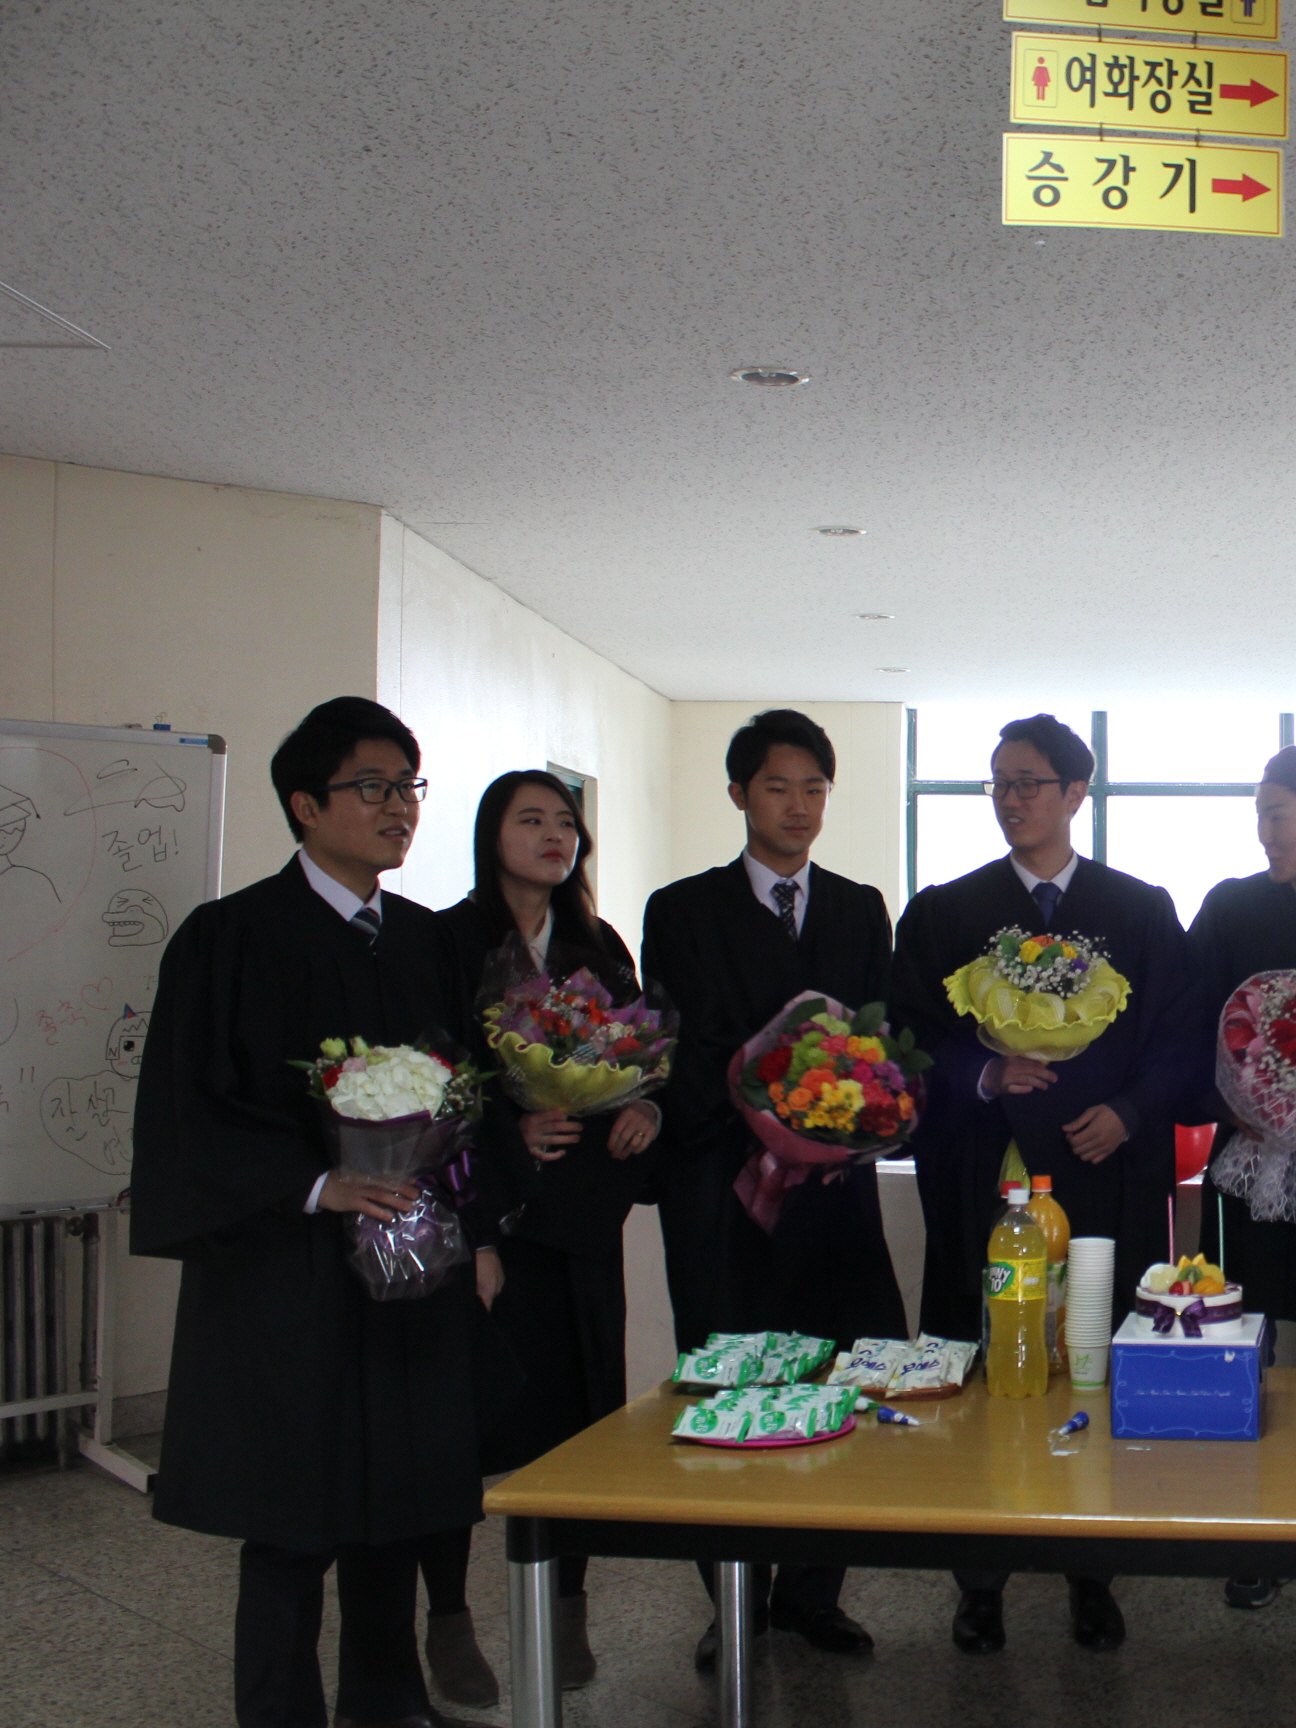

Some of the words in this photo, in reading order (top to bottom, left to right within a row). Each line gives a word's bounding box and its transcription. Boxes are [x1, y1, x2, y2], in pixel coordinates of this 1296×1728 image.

[1065, 52, 1214, 115] 여화장실
[1025, 150, 1197, 214] 승강기
[101, 825, 179, 872] 졸업!
